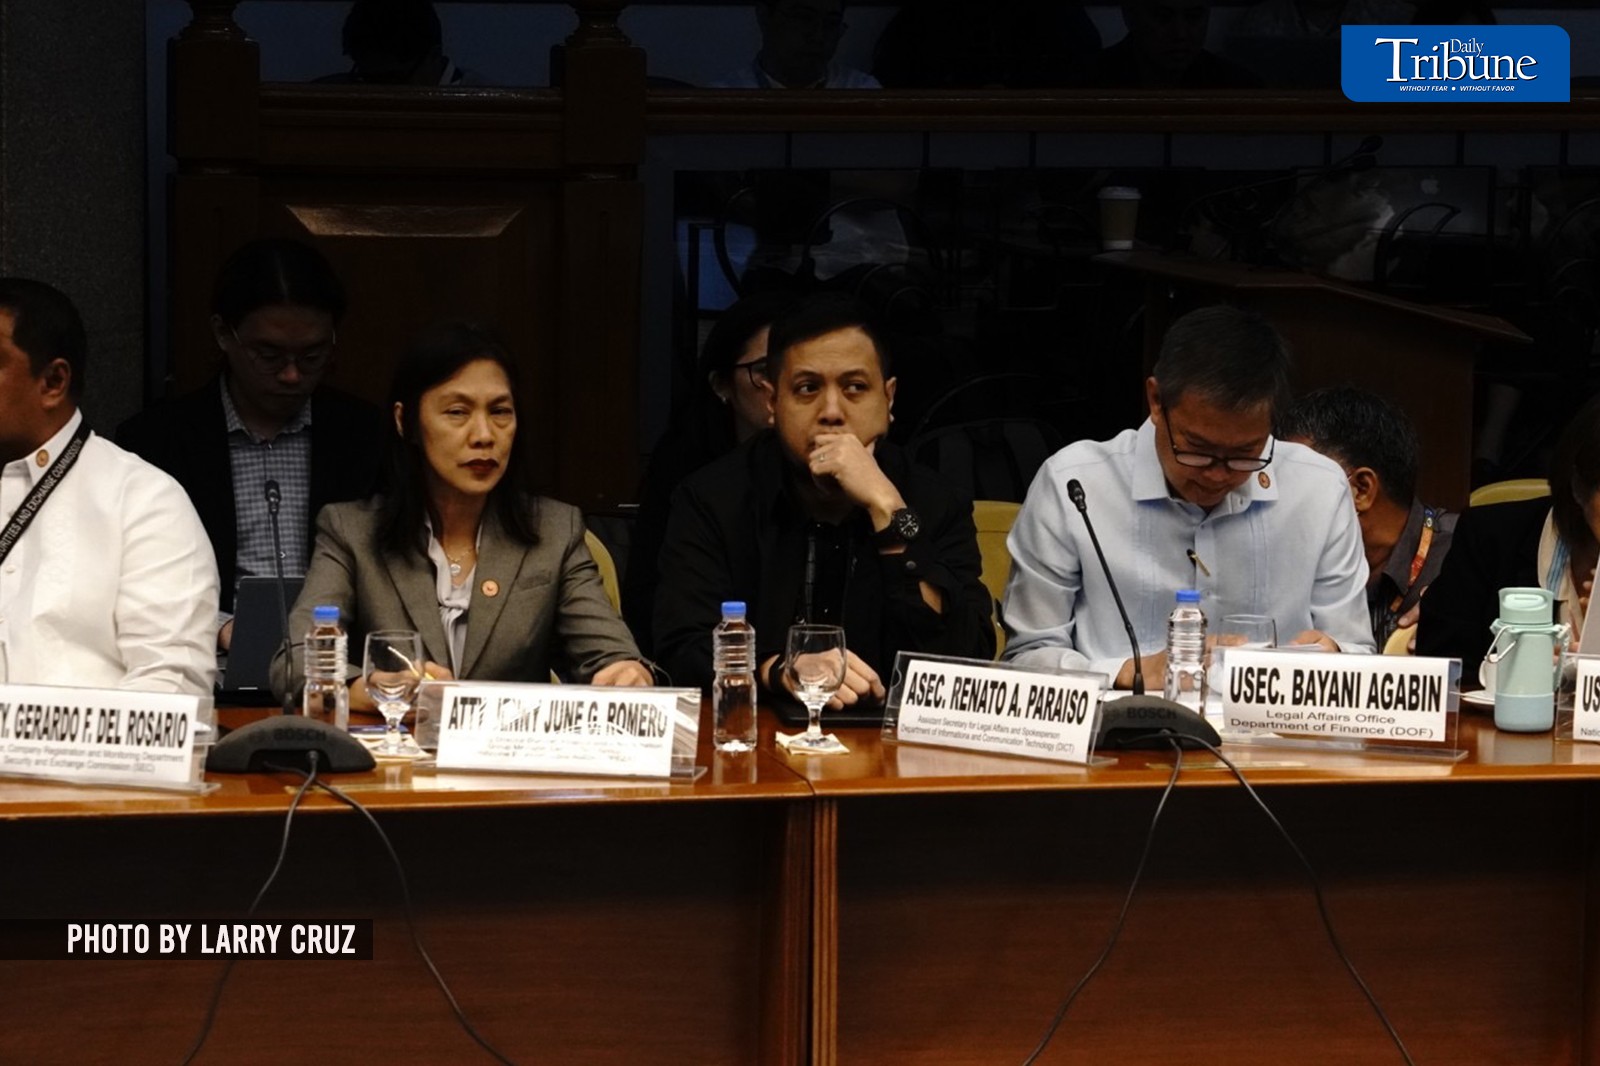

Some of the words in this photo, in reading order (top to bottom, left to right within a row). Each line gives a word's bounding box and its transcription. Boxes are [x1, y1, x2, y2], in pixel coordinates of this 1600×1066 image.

[905, 672, 945, 709] ASEC.
[949, 676, 1007, 716] RENATO
[1007, 683, 1021, 718] A.
[1025, 685, 1089, 725] PARAISO
[1230, 666, 1284, 705] USEC.
[1291, 669, 1362, 708] BAYANI
[1366, 672, 1442, 712] AGABIN
[14, 704, 80, 742] GERARDO
[82, 708, 93, 743] F.
[97, 708, 121, 745] DEL
[126, 710, 189, 748] ROSARIO
[544, 700, 584, 734] JUNE
[1127, 707, 1177, 719] BOSCH
[1266, 710, 1303, 721] Legal
[1307, 712, 1350, 722] Affairs
[1355, 714, 1395, 724] Office
[273, 729, 327, 741] BOSCH
[1231, 718, 1309, 732] Department
[1313, 722, 1326, 732] of
[1330, 723, 1385, 735] Finance
[1390, 726, 1434, 739] (DOF)
